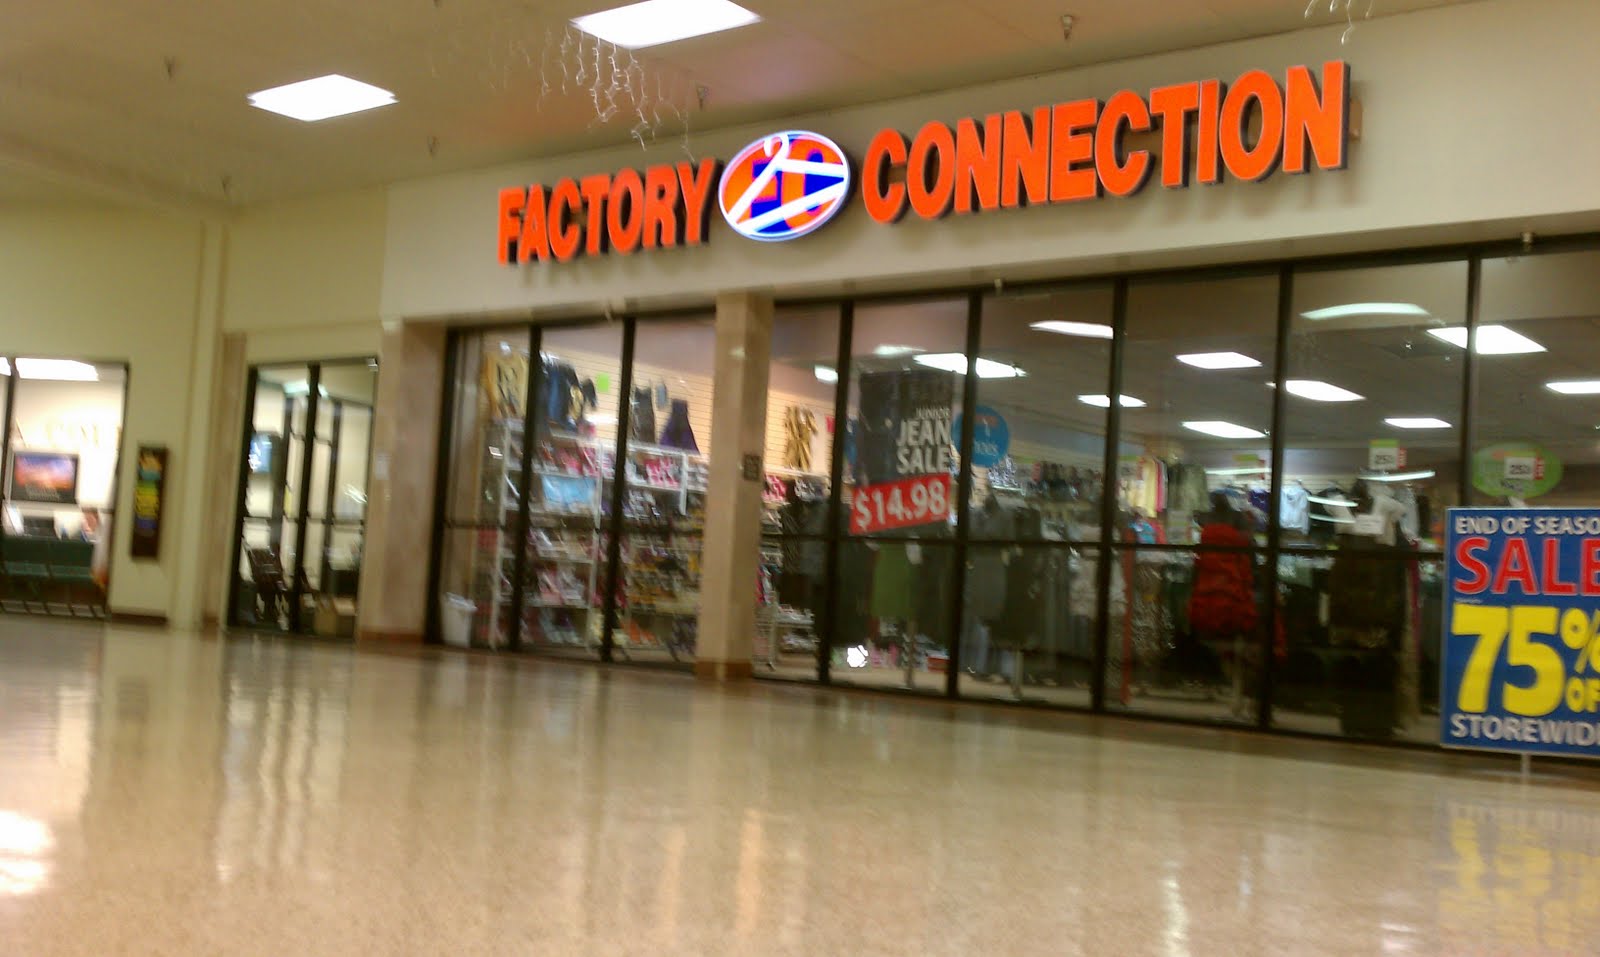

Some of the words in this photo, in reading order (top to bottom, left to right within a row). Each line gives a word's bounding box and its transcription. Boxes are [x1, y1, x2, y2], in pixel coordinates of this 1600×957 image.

[862, 60, 1349, 224] CONNECTION
[498, 159, 716, 266] FACTORY
[897, 418, 950, 447] JEAN
[896, 446, 950, 475] SALE
[854, 479, 946, 533] $14.98
[1455, 516, 1499, 534] END
[1501, 516, 1531, 535] OF
[1453, 536, 1600, 596] SALE
[1450, 713, 1600, 746] STOREWID
